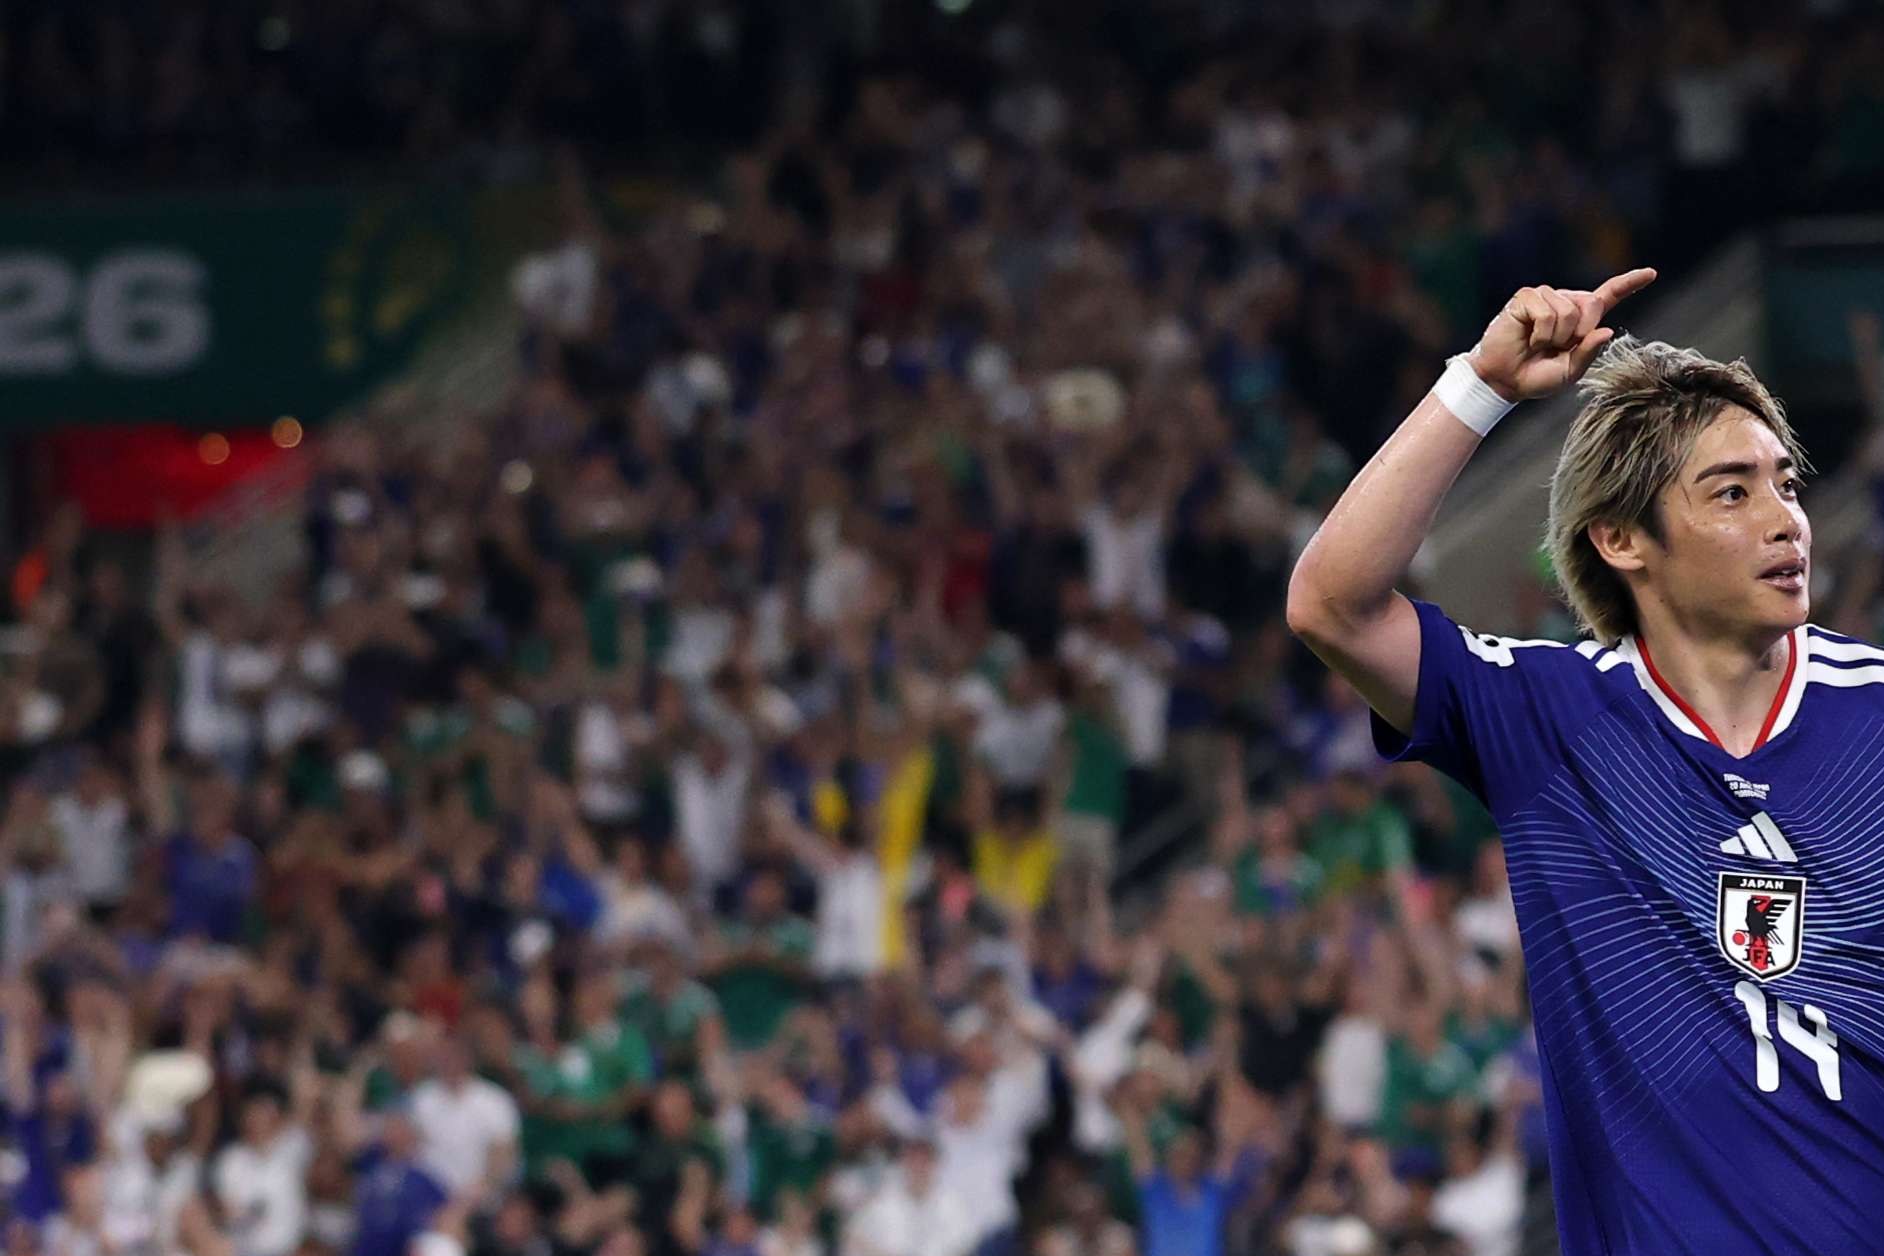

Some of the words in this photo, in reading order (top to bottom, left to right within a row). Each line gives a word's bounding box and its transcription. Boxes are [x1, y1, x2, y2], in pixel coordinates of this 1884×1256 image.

[0, 250, 208, 372] 26
[1739, 878, 1784, 890] JAPAN
[1742, 948, 1776, 967] JFA
[1734, 980, 1842, 1101] 14
